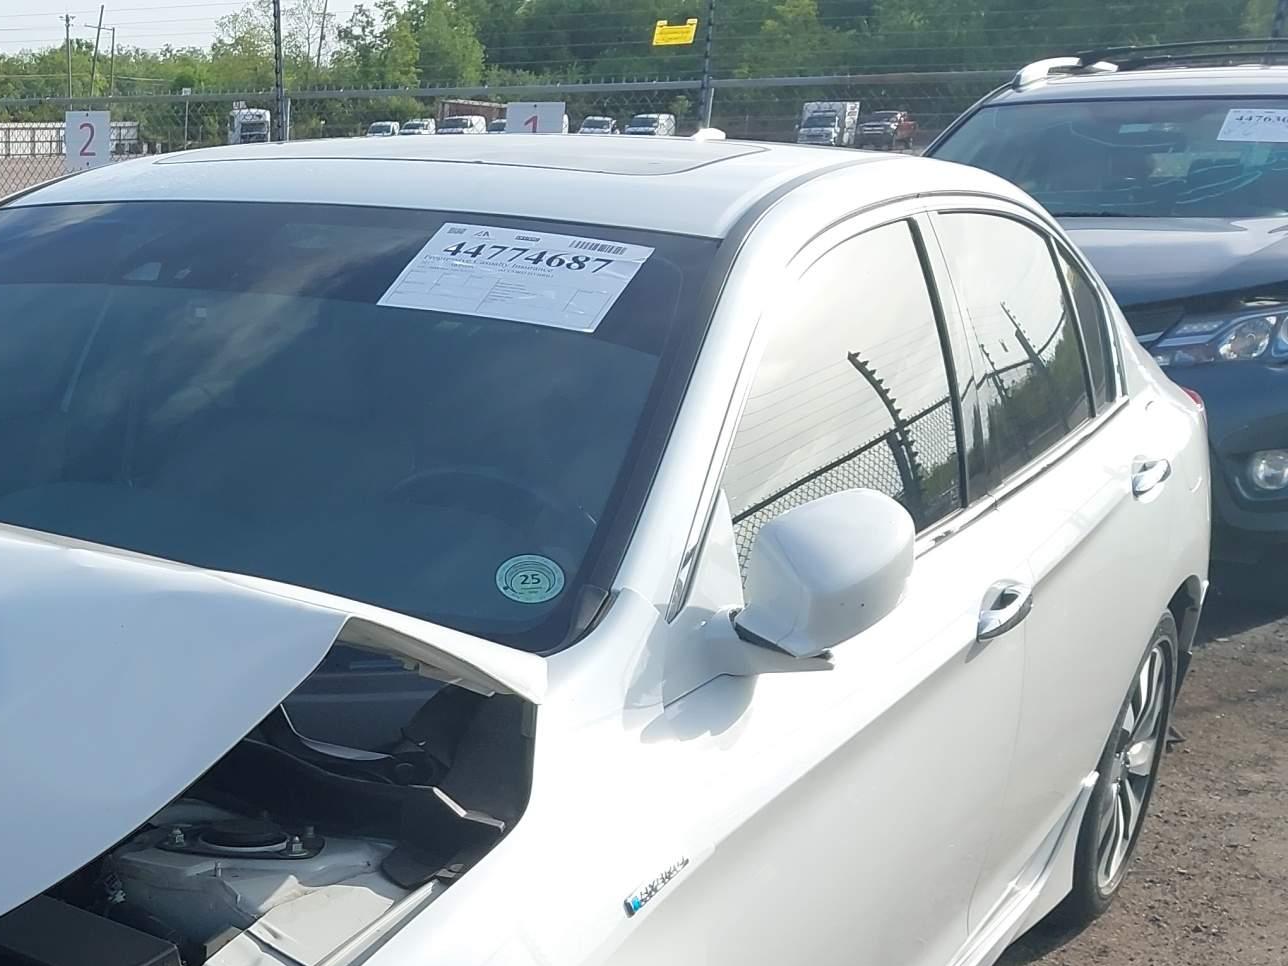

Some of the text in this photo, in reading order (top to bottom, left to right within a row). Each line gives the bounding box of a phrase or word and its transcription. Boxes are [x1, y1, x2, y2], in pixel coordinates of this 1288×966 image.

[79, 122, 96, 157] 2
[443, 242, 615, 274] 44774687
[519, 573, 541, 585] 25
